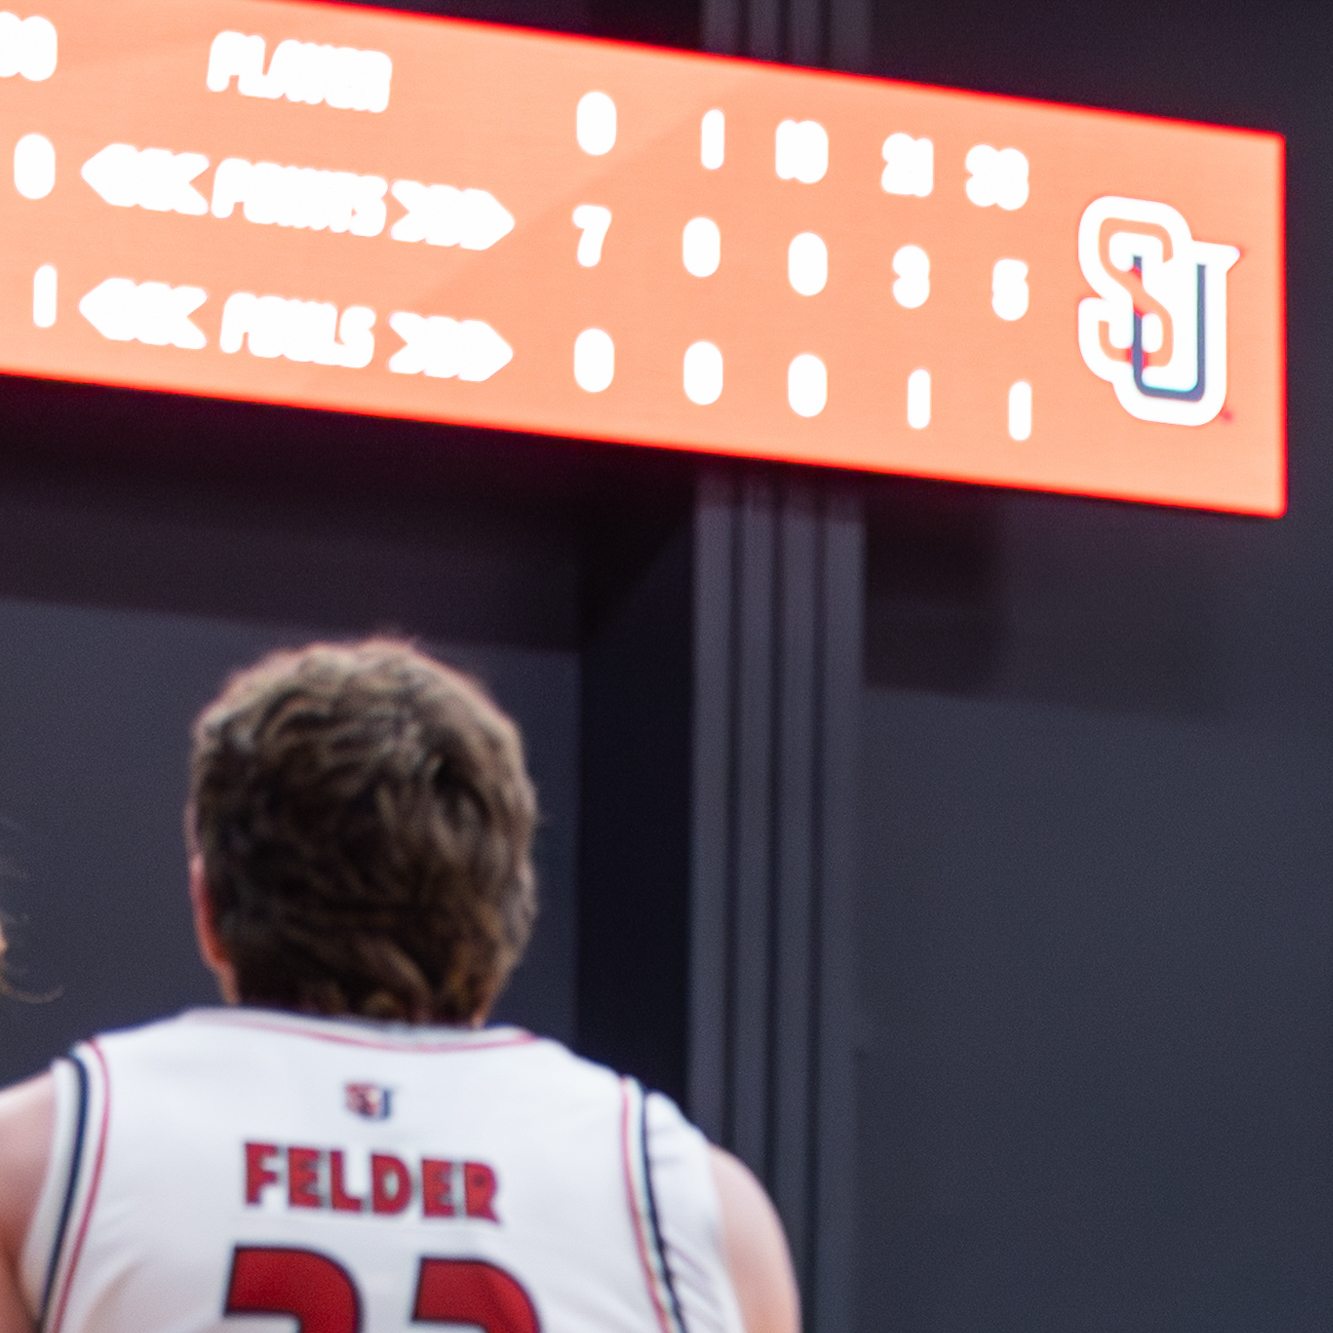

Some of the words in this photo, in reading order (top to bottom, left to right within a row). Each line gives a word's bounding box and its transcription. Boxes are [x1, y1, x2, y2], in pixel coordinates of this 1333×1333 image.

[572, 204, 612, 268] 7
[682, 217, 721, 278] 0
[788, 231, 828, 296] 0
[573, 328, 615, 393] 0
[683, 340, 724, 406] 0
[787, 353, 827, 418] 0
[243, 1142, 501, 1225] FELDER
